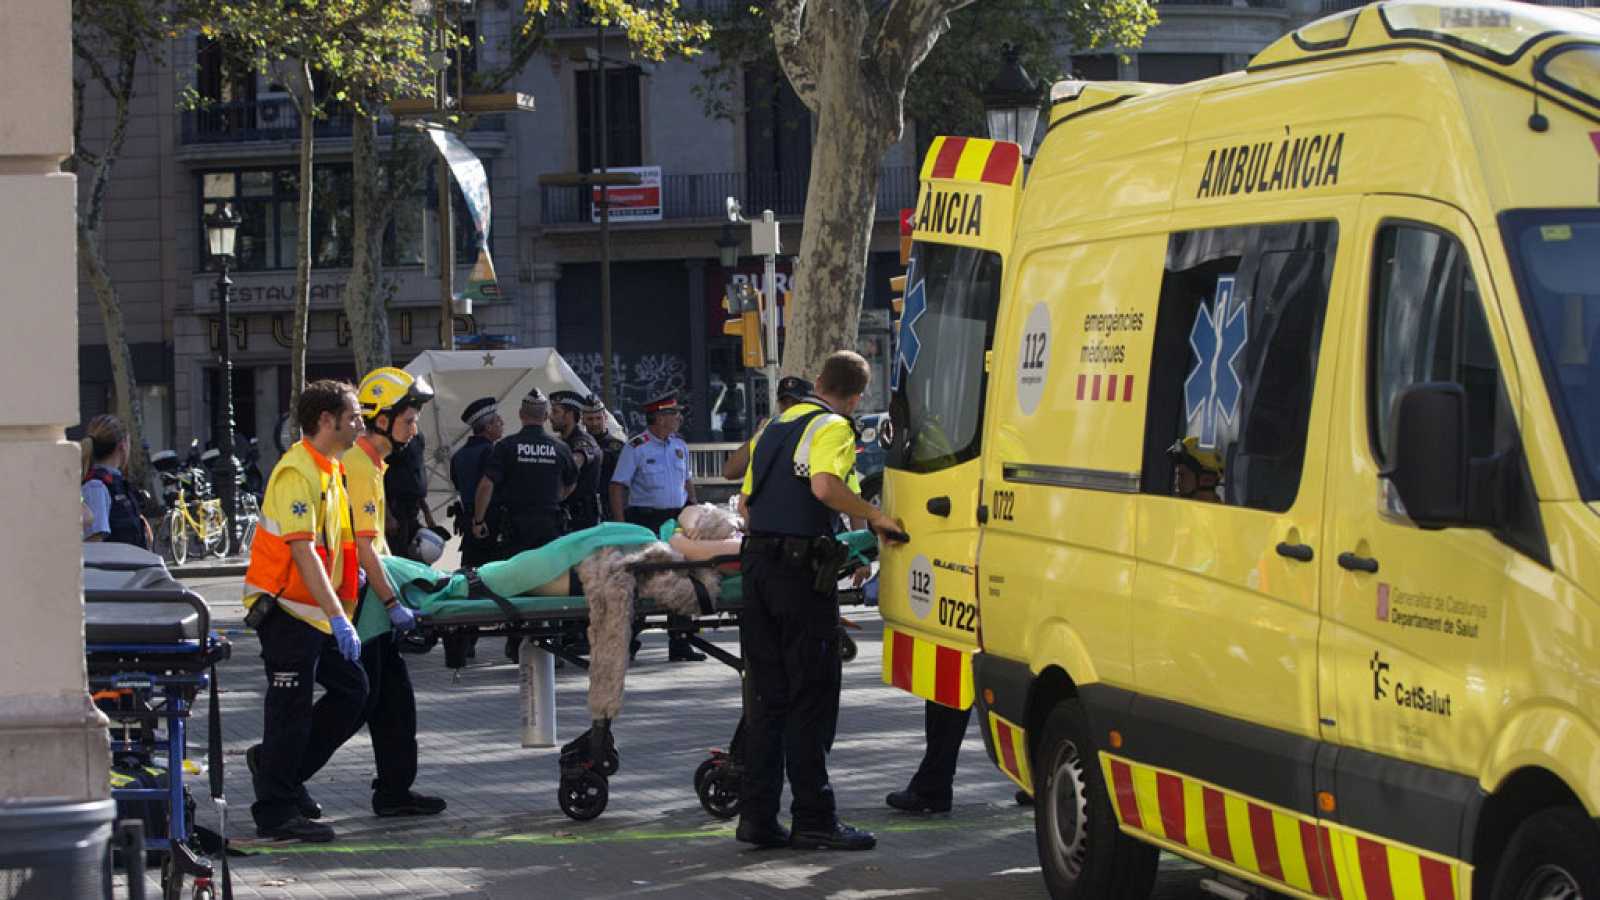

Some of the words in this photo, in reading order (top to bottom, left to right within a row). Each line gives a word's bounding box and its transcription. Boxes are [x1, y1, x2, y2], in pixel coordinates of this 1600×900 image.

[1196, 125, 1345, 199] AMBULÀNCIA
[913, 181, 983, 237] ÀNCIA
[1022, 332, 1047, 370] 112
[517, 443, 557, 457] POLICIA
[993, 489, 1015, 521] 0722
[911, 569, 931, 595] 112
[939, 596, 976, 633] 0722
[1443, 618, 1454, 634] de
[1394, 682, 1451, 717] CatSalut
